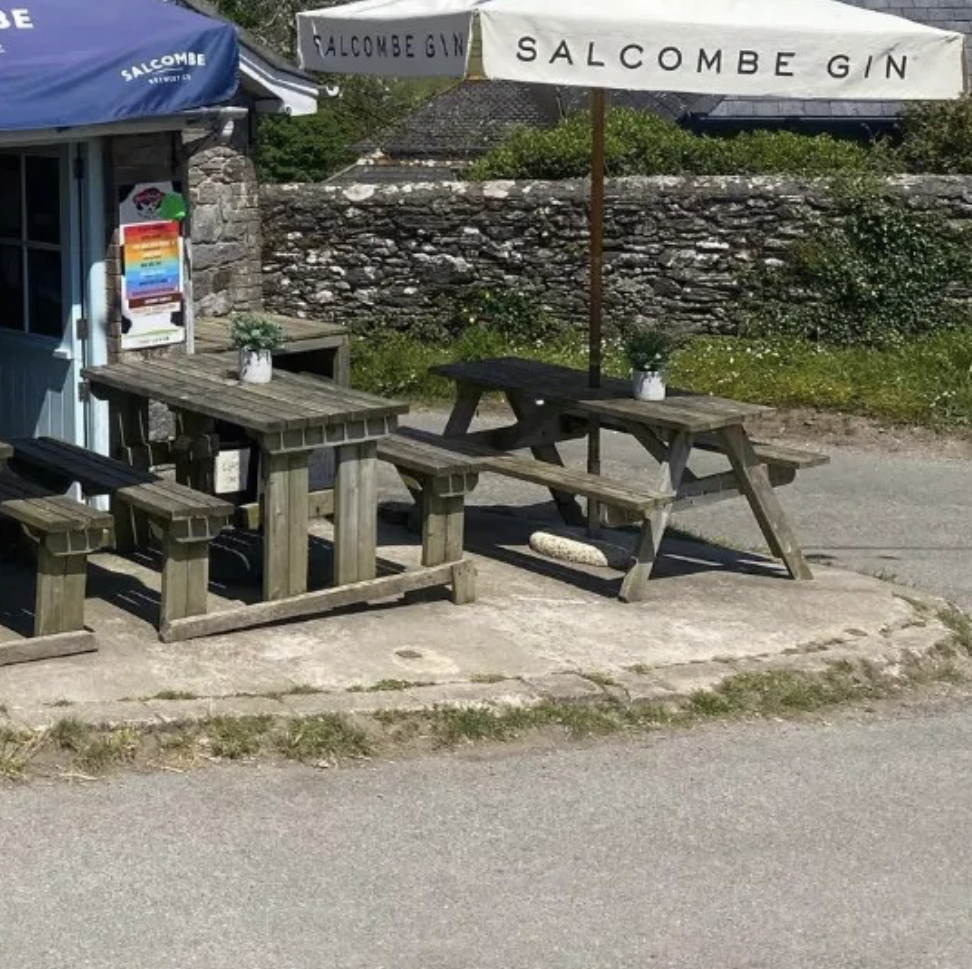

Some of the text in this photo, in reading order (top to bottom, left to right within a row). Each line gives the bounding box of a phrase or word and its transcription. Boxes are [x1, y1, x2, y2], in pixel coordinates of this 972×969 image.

[425, 33, 463, 58] GIN
[516, 35, 908, 80] SALCOMBE GIN
[120, 51, 206, 82] SALCOMBE
